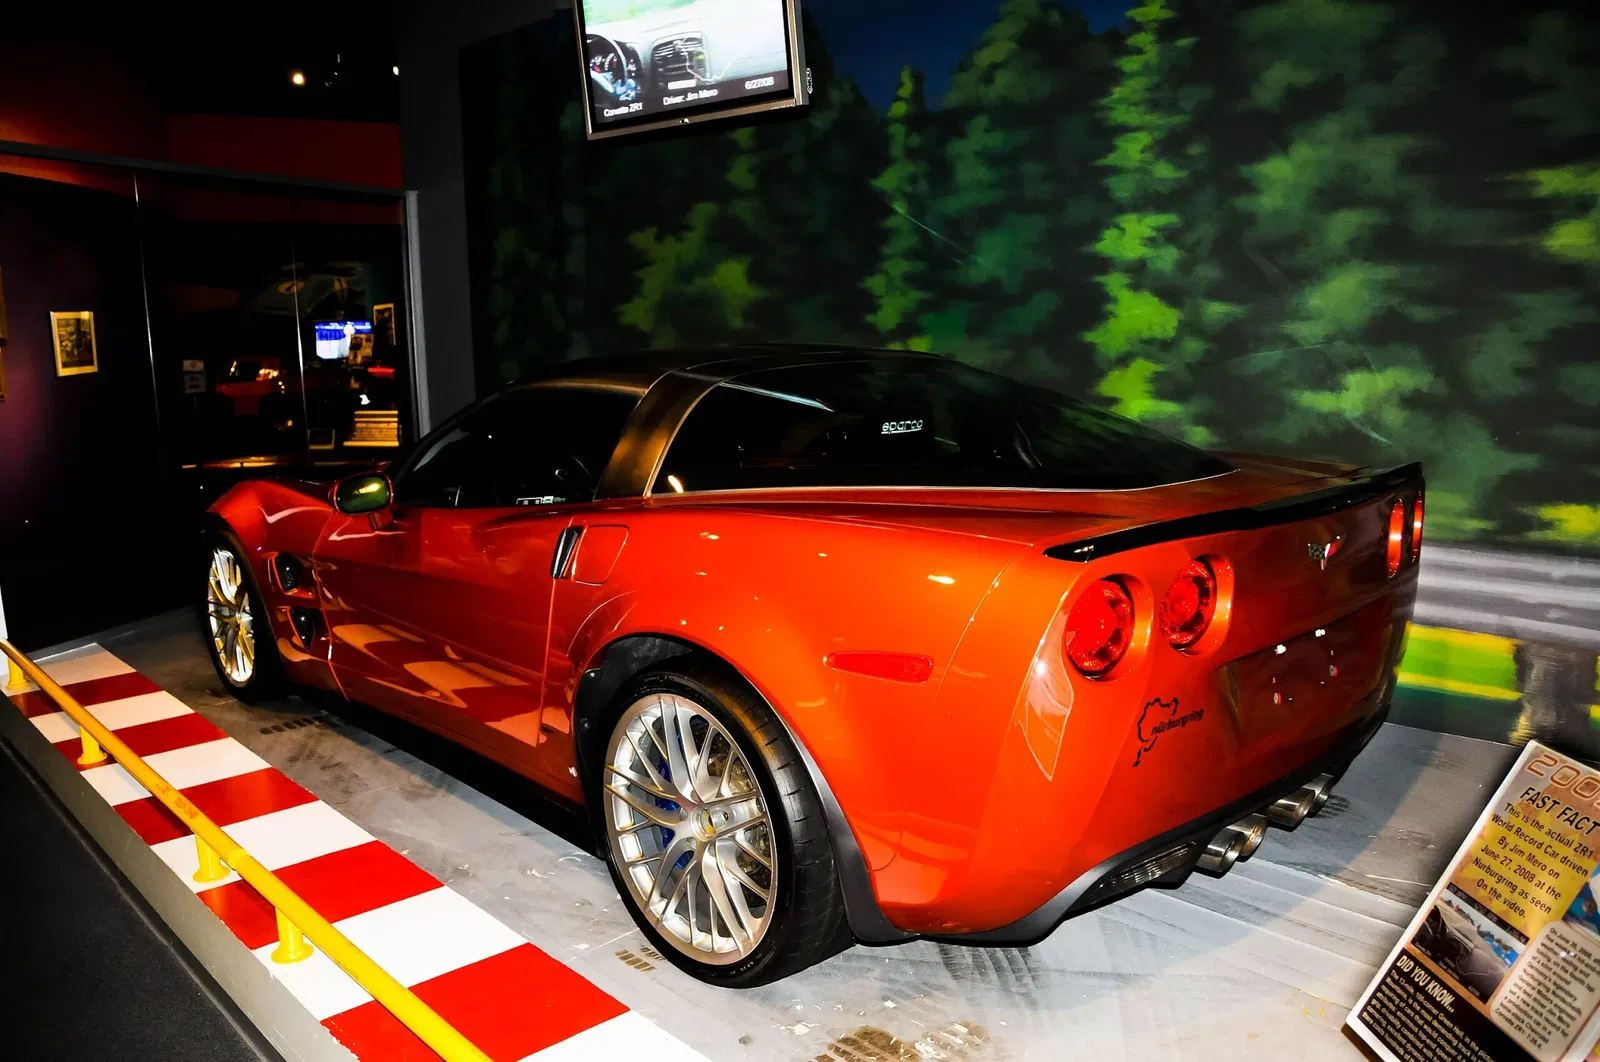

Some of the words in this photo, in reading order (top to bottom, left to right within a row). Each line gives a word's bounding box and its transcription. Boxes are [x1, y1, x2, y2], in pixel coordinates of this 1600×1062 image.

[629, 102, 643, 112] ZR1
[686, 92, 698, 102] Jim
[882, 419, 923, 434] sparco
[1519, 786, 1561, 814] FAST
[1526, 753, 1600, 810] 200
[1491, 813, 1515, 832] World
[1514, 826, 1544, 849] Record
[1544, 844, 1560, 860] Car
[1560, 855, 1588, 877] driven
[1504, 802, 1521, 818] This
[1522, 815, 1529, 824] is
[1530, 819, 1545, 832] the
[1545, 829, 1574, 848] actual
[1573, 842, 1594, 859] ZR1
[1481, 845, 1500, 860] June
[1500, 856, 1513, 870] 27,
[1513, 864, 1536, 883] 2008
[1534, 880, 1546, 890] at
[1545, 885, 1561, 900] the
[1498, 836, 1510, 850] By
[1509, 844, 1525, 858] Jim
[1526, 853, 1547, 872] Mero
[1548, 868, 1560, 879] on
[1472, 856, 1518, 893] Nurburgring
[1518, 888, 1530, 899] as
[1529, 896, 1552, 914] seen
[1476, 878, 1488, 891] On
[1488, 887, 1502, 900] the
[1502, 897, 1526, 918] video.
[1396, 955, 1414, 972] DID
[1410, 966, 1431, 986] YOU
[1425, 980, 1455, 1013] KNOW...
[1438, 1013, 1453, 1028] Green
